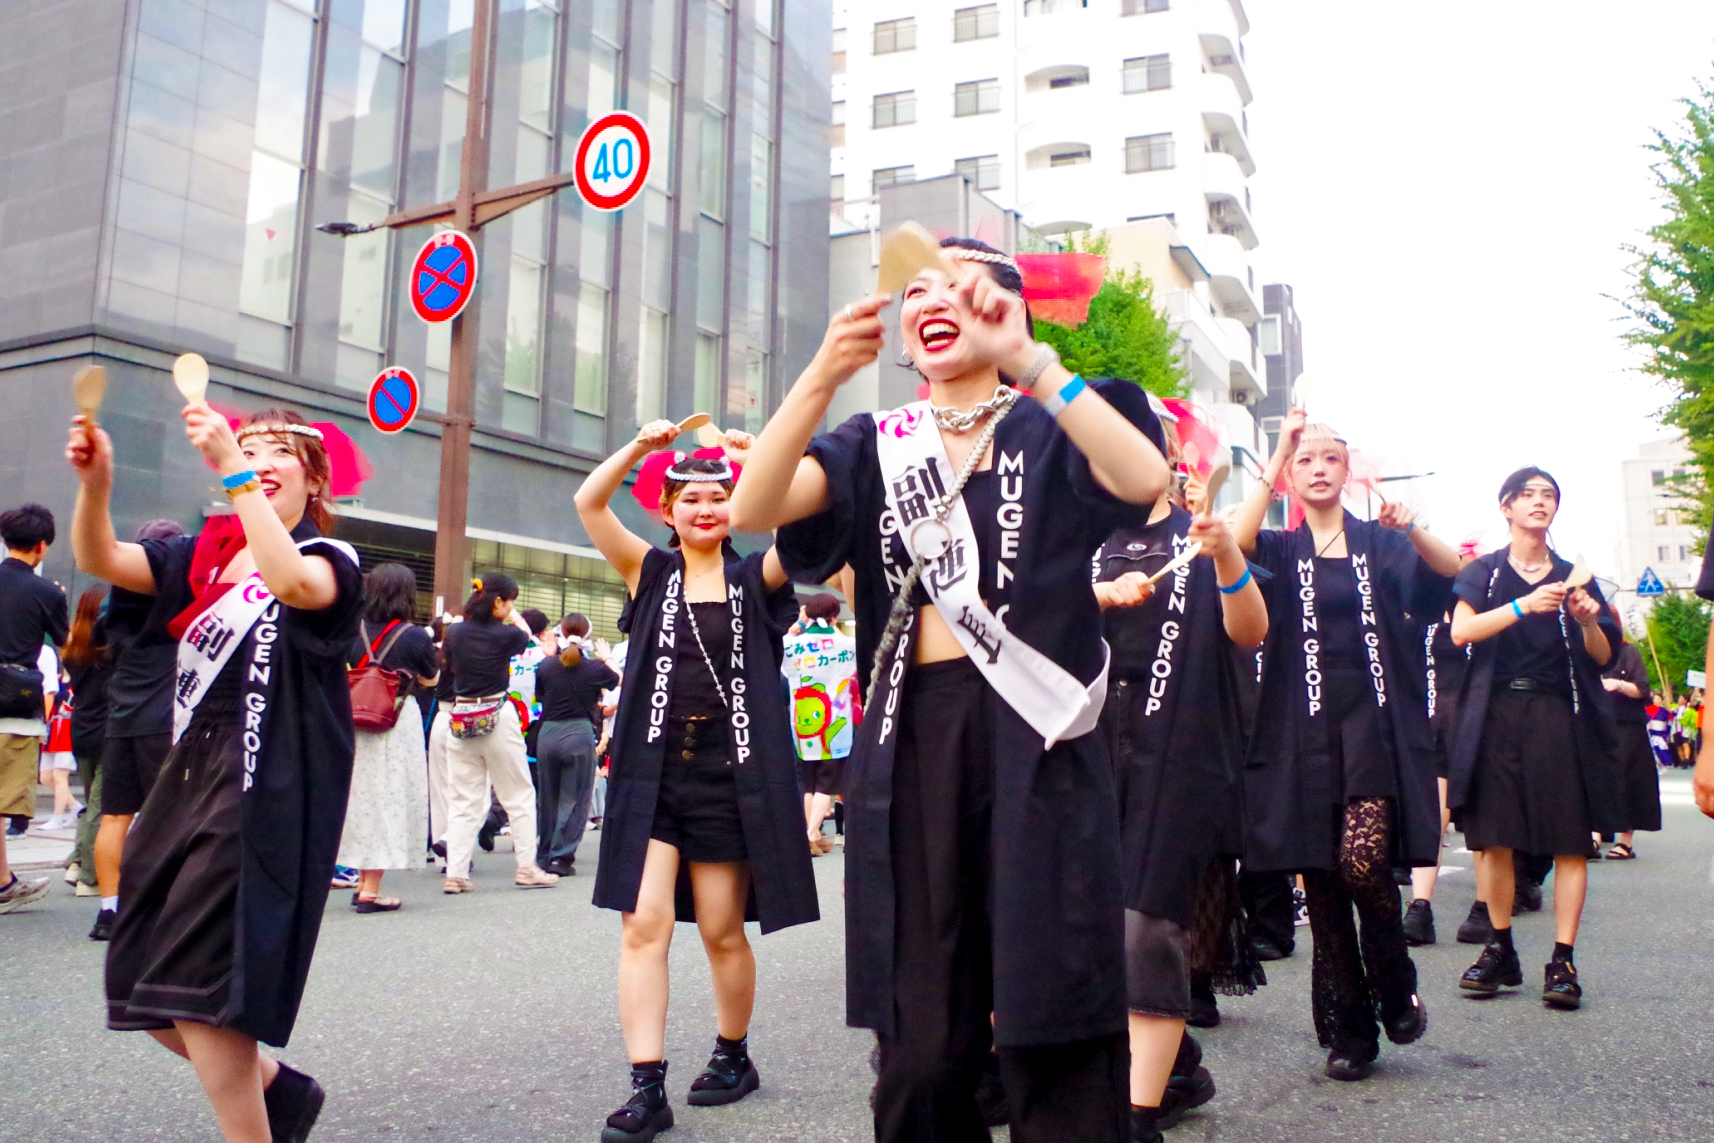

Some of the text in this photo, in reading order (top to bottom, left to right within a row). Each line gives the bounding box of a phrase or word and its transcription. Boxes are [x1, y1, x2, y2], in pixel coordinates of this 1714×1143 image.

[592, 138, 633, 183] 40
[997, 450, 1024, 590] MUGEN
[243, 604, 280, 792] UGEN GROUP
[647, 569, 682, 743] MUGEN GROUP
[728, 583, 751, 764] MUGEN GROUP
[1145, 621, 1180, 716] GROUP
[1297, 558, 1322, 716] MUGEN GROUP
[1352, 553, 1386, 707] MUGEN GROUP
[1426, 669, 1437, 718] GROUP
